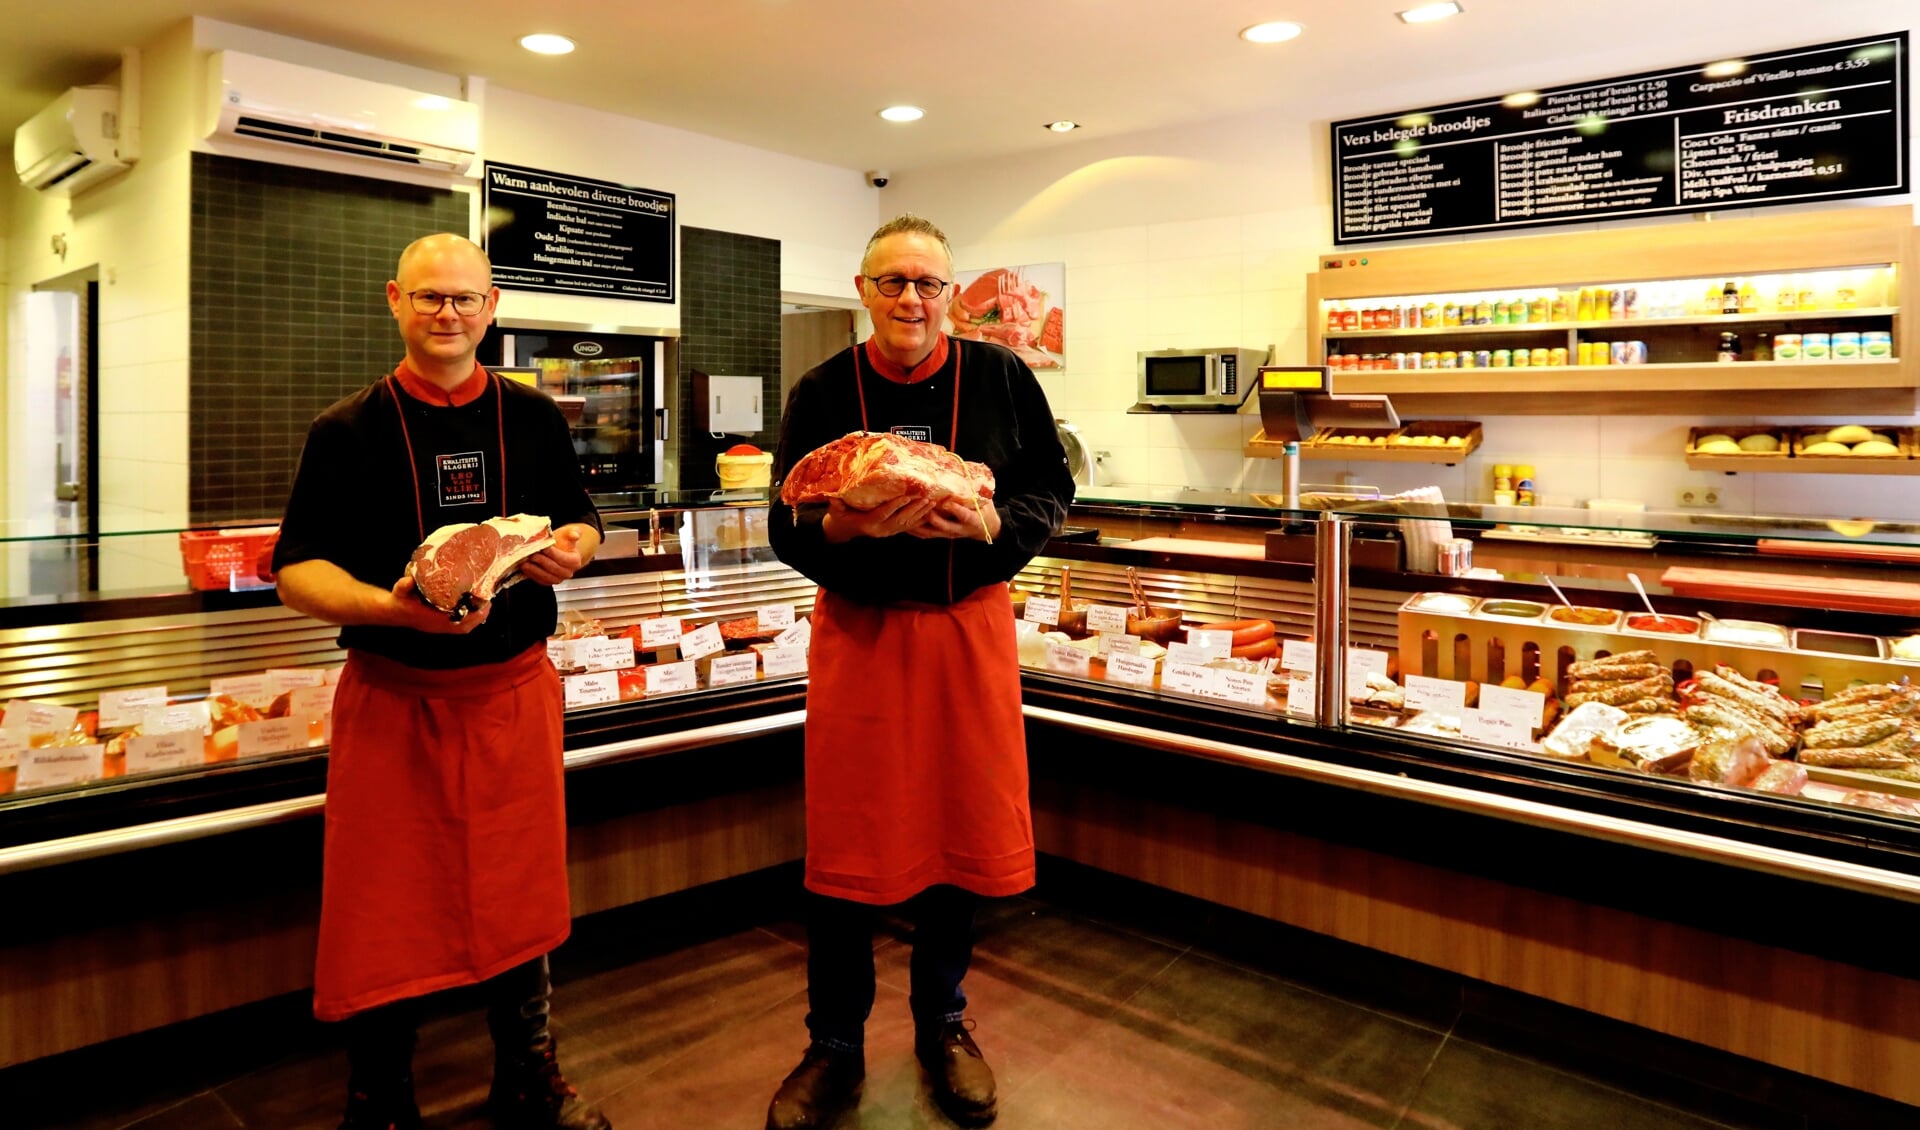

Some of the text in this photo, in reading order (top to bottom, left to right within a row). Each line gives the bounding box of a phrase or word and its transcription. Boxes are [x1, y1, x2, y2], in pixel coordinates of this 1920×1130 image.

[1689, 78, 1742, 92] Carpaccio
[1743, 74, 1756, 85] of
[1757, 69, 1795, 83] Vitello
[1835, 61, 1843, 71] €
[1547, 94, 1581, 105] Pistolet
[1582, 91, 1598, 100] wit
[1599, 88, 1610, 99] of
[1611, 85, 1637, 96] bruin
[1523, 106, 1565, 118] Italiaanse
[1582, 100, 1598, 109] wit
[1599, 98, 1610, 107] of
[1611, 95, 1637, 106] bruin
[1547, 112, 1585, 124] Ciabatta
[1600, 103, 1635, 116] triangel
[1638, 103, 1645, 111] €
[1723, 99, 1841, 125] Frisdranken
[1343, 116, 1491, 146] Vers belegde broodjes
[1681, 122, 1841, 148] Coca Cola Fanta sinas / cassis
[1500, 136, 1582, 153] Broodje fricandeau
[1682, 143, 1756, 160] Lipton Ice Tea
[1500, 150, 1534, 162] Broodje
[1500, 150, 1622, 172] Broodje gezond zonder ham
[1682, 156, 1742, 169] Chocomelk
[1743, 153, 1750, 162] /
[1344, 163, 1372, 173] Broodje
[1500, 169, 1534, 180] Broodje
[1555, 166, 1576, 174] naar
[1577, 162, 1604, 171] keuze
[1682, 169, 1704, 179] Div.
[1705, 165, 1745, 177] smaken
[1344, 172, 1372, 182] Broodje
[1500, 178, 1534, 190] Broodje
[1584, 172, 1602, 180] met
[1603, 169, 1613, 178] ei
[1682, 178, 1709, 189] Melk
[1710, 174, 1747, 186] halfvol
[1748, 173, 1756, 182] /
[1756, 167, 1816, 182] karnemelk
[492, 172, 668, 213] Warm aanbevolen diverse broodjes
[1344, 180, 1372, 190] Broodje
[1344, 188, 1372, 198] Broodje
[1436, 180, 1451, 188] met
[1452, 178, 1460, 186] ei
[1682, 184, 1767, 199] Flesje Spa Water
[1500, 187, 1535, 199] Broodje
[1344, 197, 1373, 207] Broodje
[1500, 197, 1535, 208] Broodje
[546, 211, 575, 223] Indische
[576, 215, 586, 224] bal
[1344, 205, 1373, 215] Broodje
[1501, 206, 1535, 217] Broodje
[1344, 214, 1373, 224] Broodje
[1344, 222, 1372, 232] Broodje
[534, 232, 566, 243] Oude Jan
[533, 253, 581, 265] Huisgemaakte
[582, 258, 592, 267] bal
[443, 457, 478, 465] KWALITEITS
